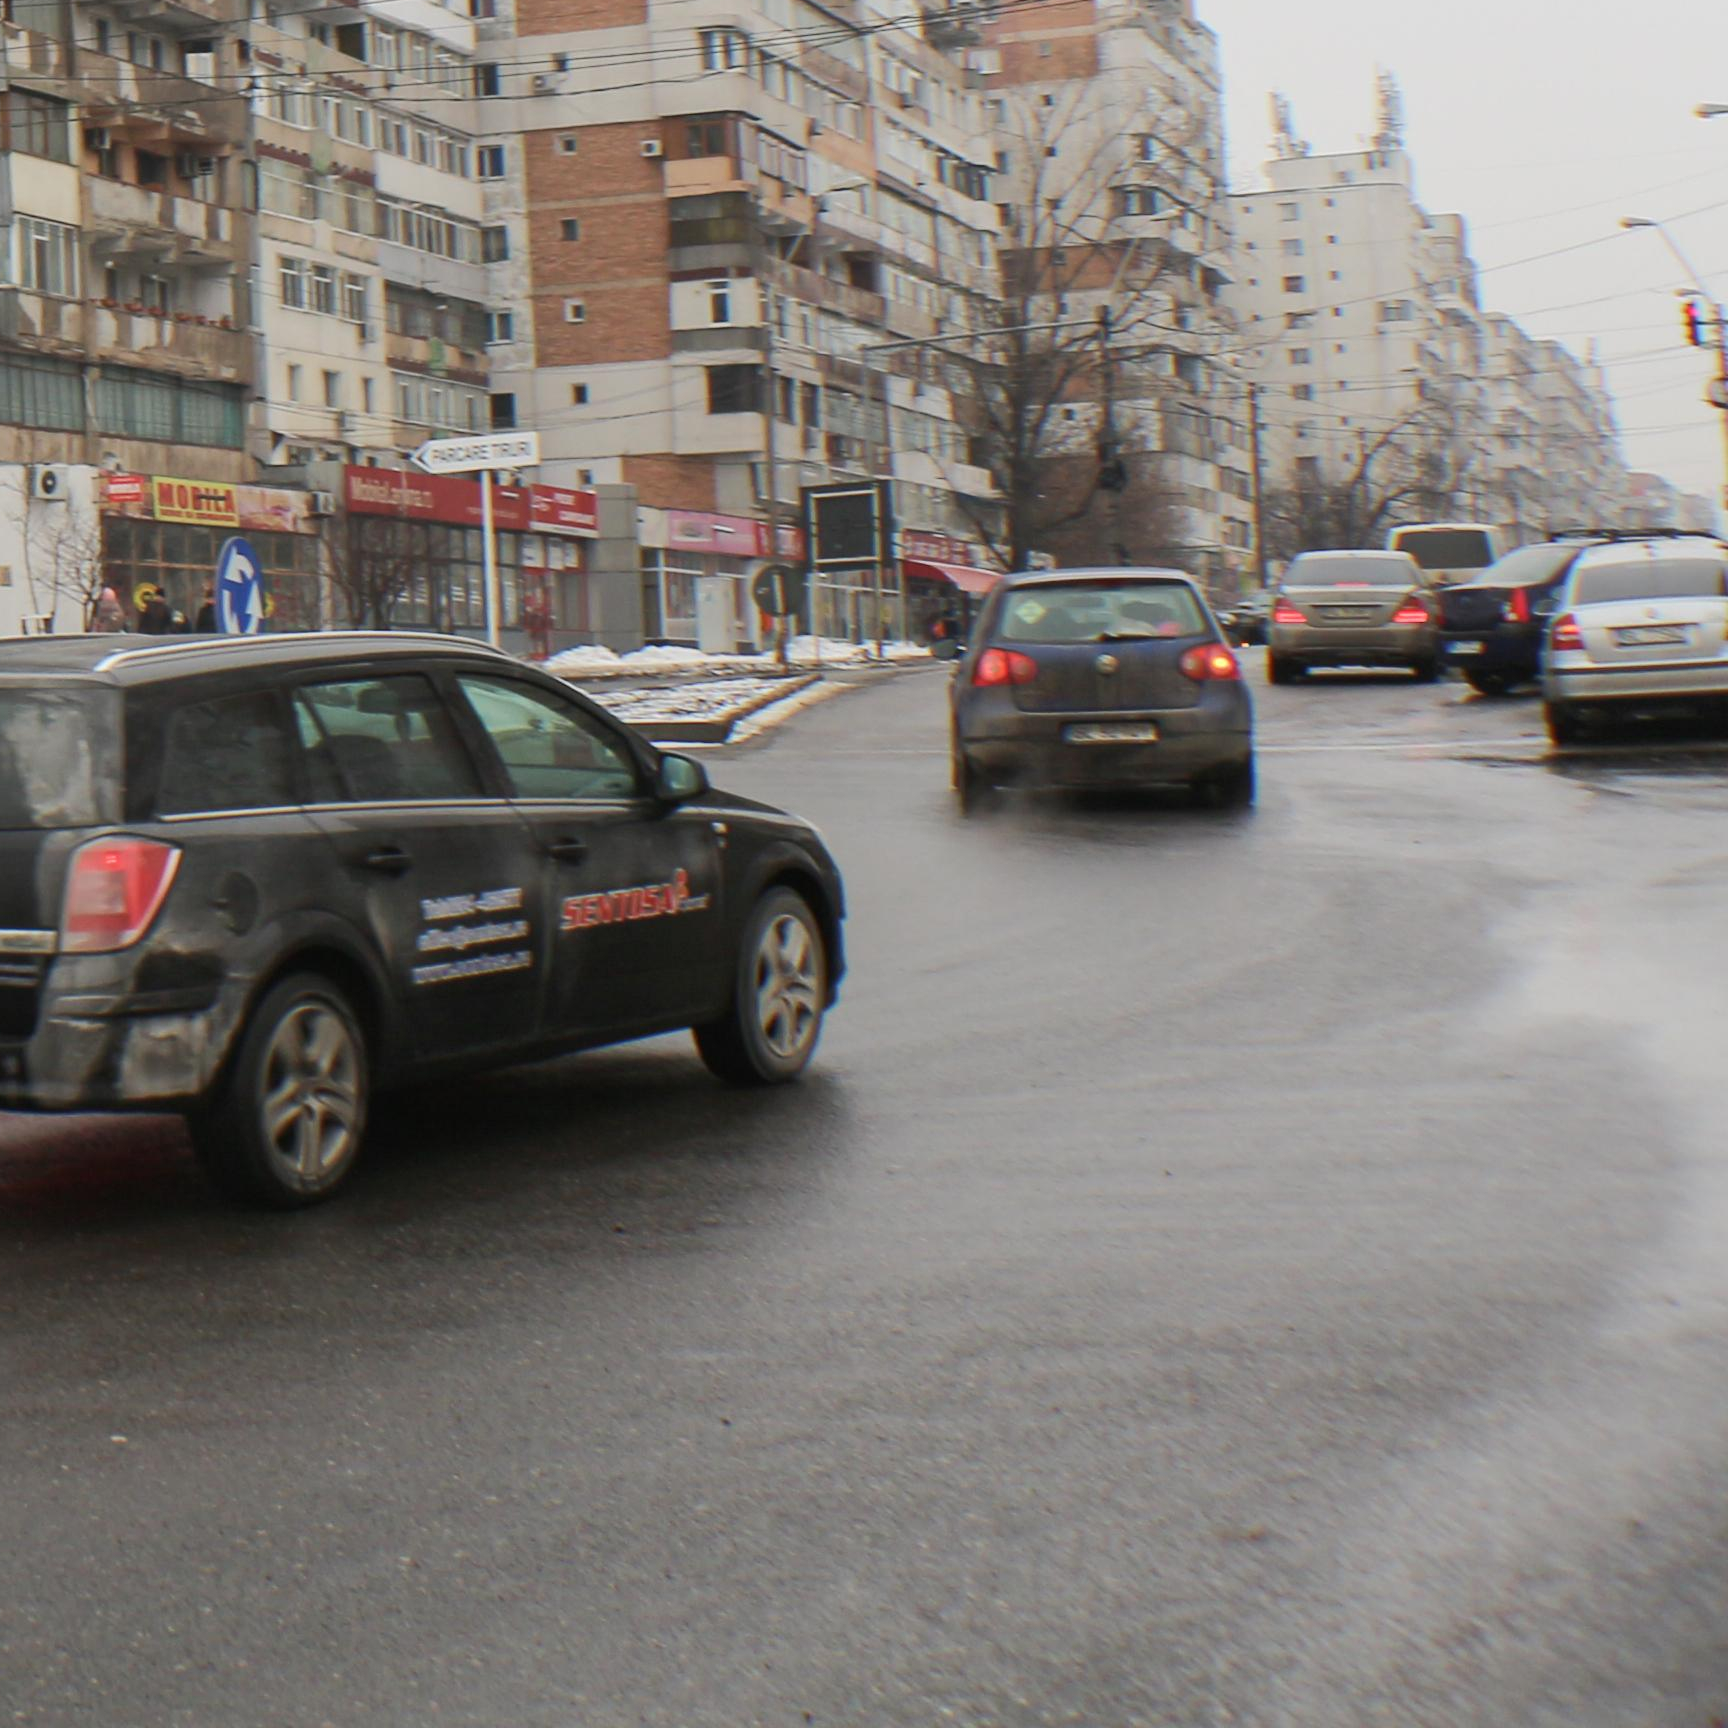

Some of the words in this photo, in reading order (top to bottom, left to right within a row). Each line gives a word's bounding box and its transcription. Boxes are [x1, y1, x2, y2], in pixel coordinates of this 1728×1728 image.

[431, 444, 489, 464] PARCARE
[157, 481, 237, 513] MOBILA
[560, 883, 677, 931] SENTOSA
